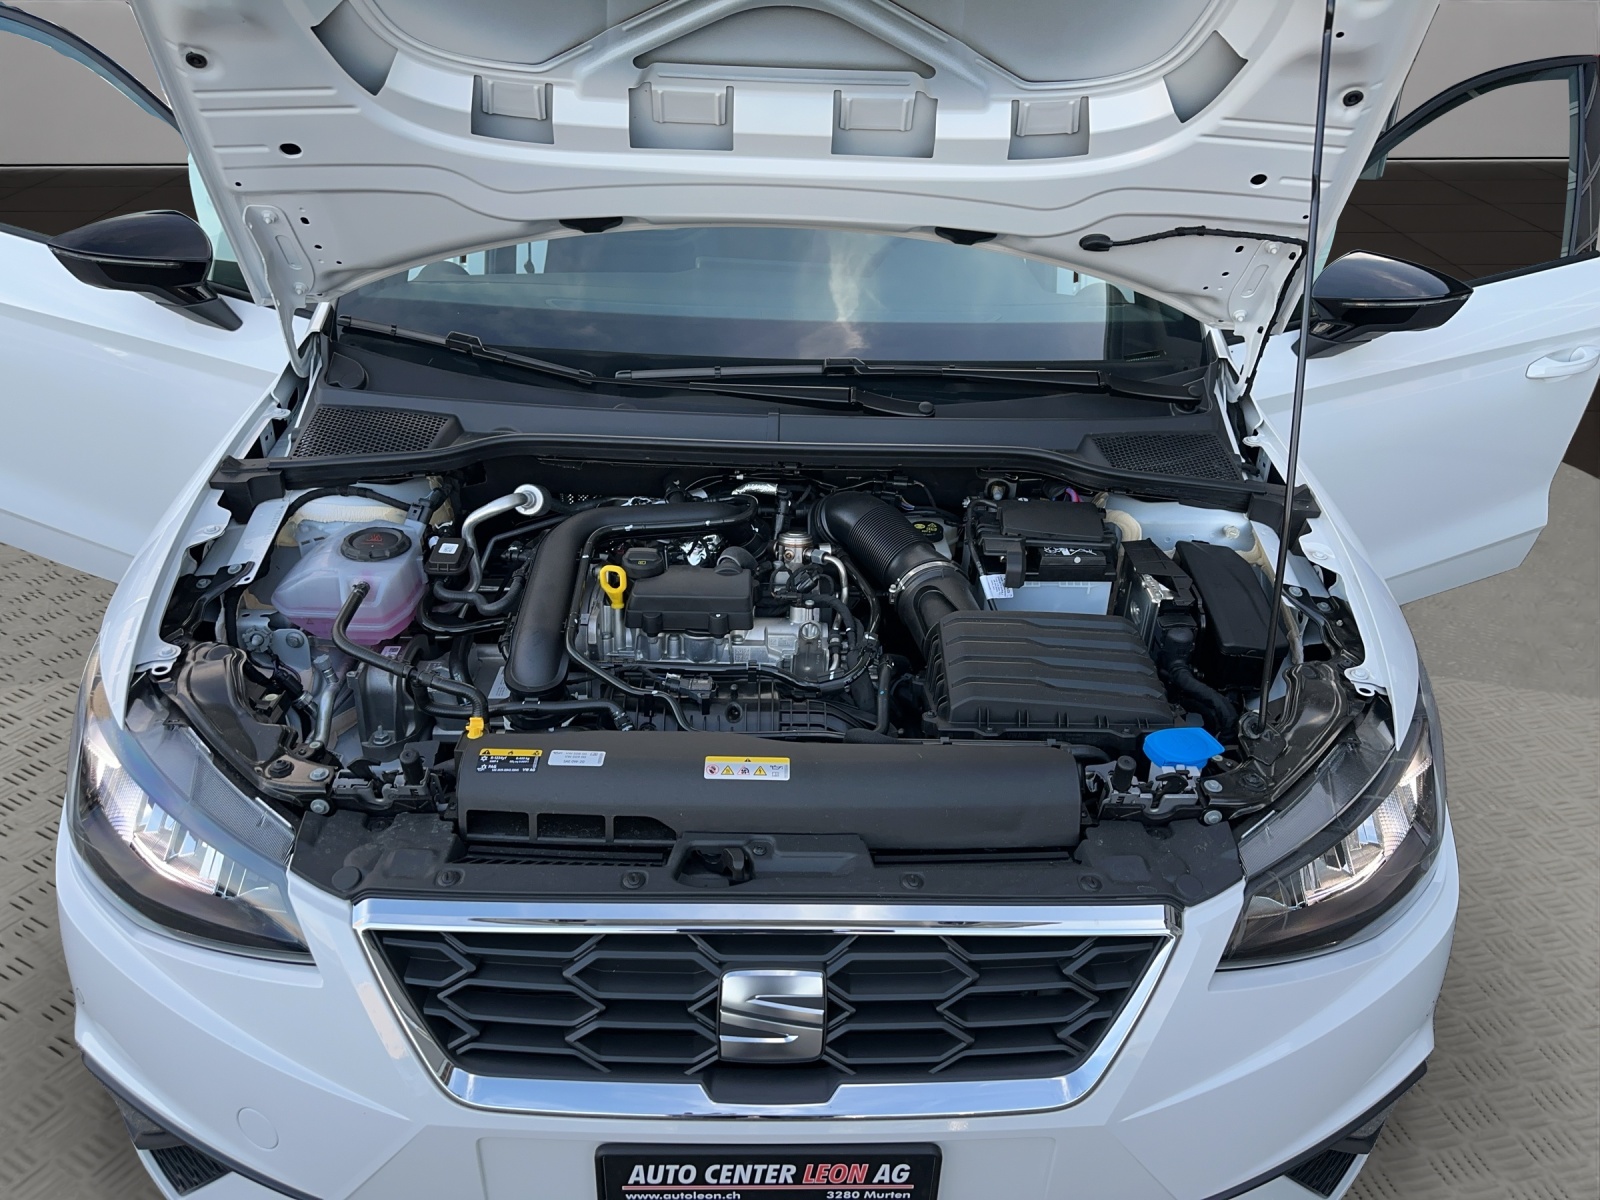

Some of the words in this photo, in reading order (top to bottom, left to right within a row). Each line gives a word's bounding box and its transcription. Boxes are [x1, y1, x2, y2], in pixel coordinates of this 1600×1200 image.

[628, 1164, 697, 1185] AUTO
[704, 1164, 797, 1185] CENTER
[802, 1163, 869, 1184] LEON
[872, 1164, 911, 1183] AG
[625, 1191, 741, 1200] www.autoleon.ch
[826, 1191, 860, 1199] 3280
[863, 1191, 911, 1199] Murten
